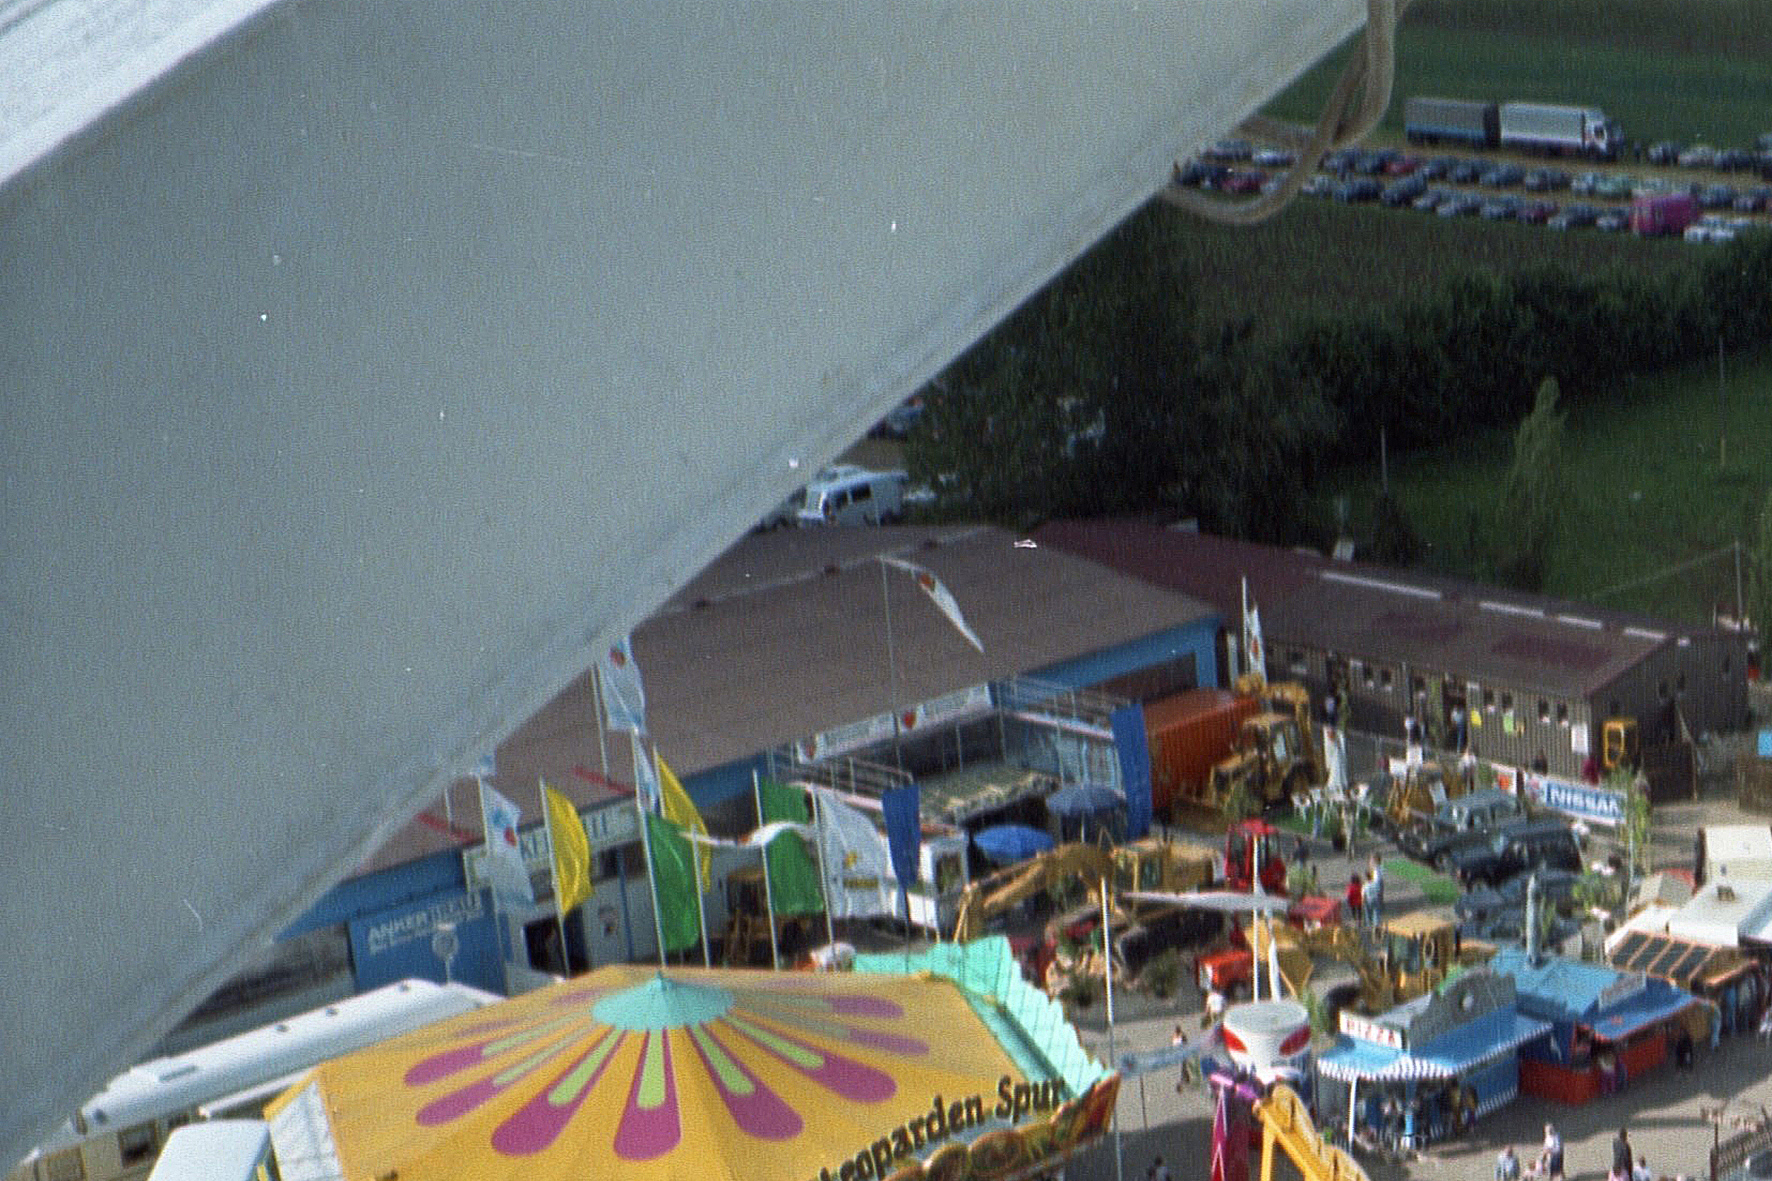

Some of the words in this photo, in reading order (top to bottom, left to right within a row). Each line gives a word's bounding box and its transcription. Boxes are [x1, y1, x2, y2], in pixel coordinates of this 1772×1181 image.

[1549, 785, 1620, 818] NISSAN
[1344, 1018, 1395, 1047] PIZZA
[995, 1075, 1065, 1126] Spur
